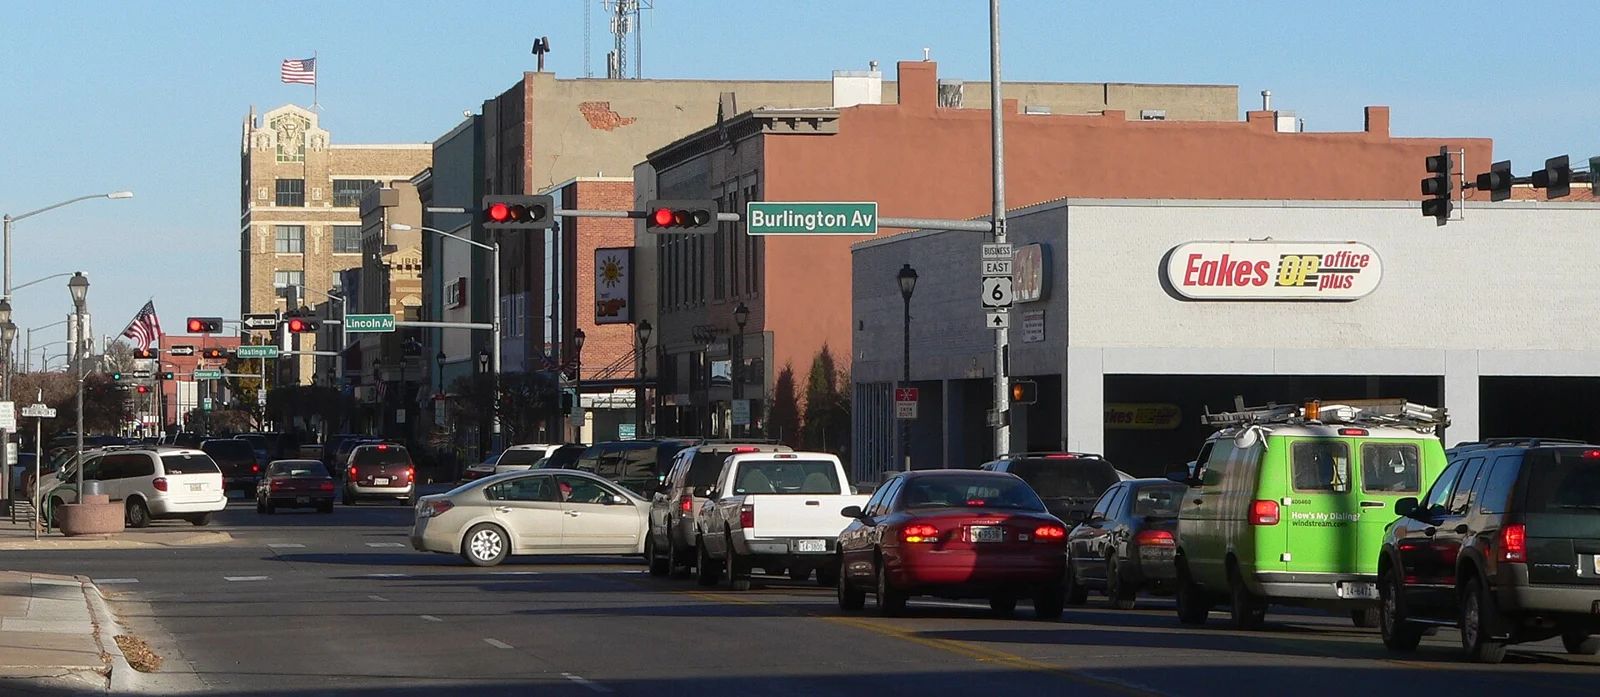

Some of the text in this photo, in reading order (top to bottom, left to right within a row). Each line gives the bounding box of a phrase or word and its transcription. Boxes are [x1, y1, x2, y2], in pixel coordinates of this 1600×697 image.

[752, 210, 872, 231] Burlington Av
[984, 247, 1010, 256] BUSINESS
[1324, 251, 1370, 268] office
[986, 263, 1009, 273] EAST
[1183, 253, 1320, 287] Eakes OP
[1318, 273, 1354, 291] plus
[991, 283, 1003, 301] 6
[346, 315, 393, 328] Lincoln Av
[239, 348, 266, 356] Hastings
[1104, 408, 1134, 424] akes
[1291, 511, 1361, 522] How's My Dialing?
